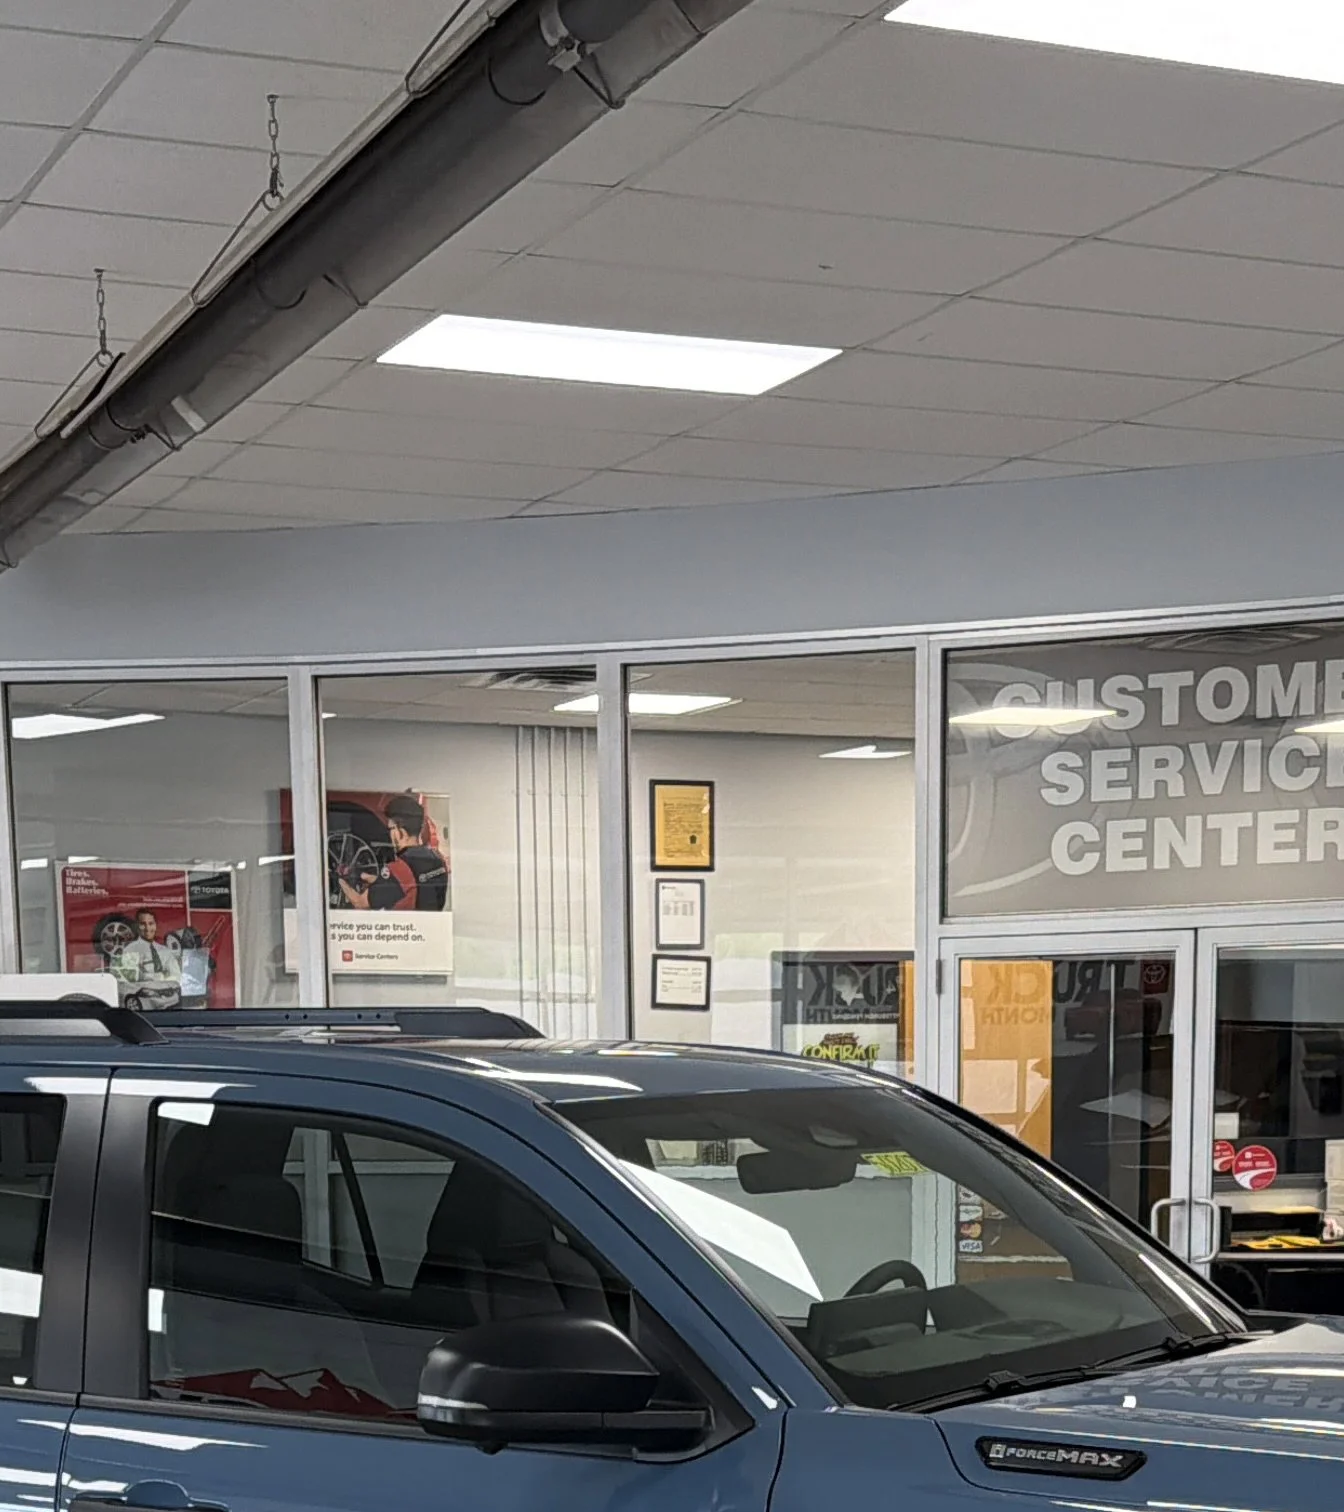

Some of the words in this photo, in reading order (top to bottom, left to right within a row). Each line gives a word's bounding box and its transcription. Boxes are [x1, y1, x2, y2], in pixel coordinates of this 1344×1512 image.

[65, 868, 90, 877] Tires.
[65, 877, 99, 886] Brakes.
[65, 885, 109, 896] Batteries.
[330, 923, 354, 931] ervice
[356, 923, 373, 935] you
[393, 923, 417, 931] trust.
[337, 933, 355, 945] you
[357, 933, 373, 941] can
[375, 932, 409, 943] depend
[411, 934, 425, 942] on.
[801, 1043, 867, 1062] CONFIRM
